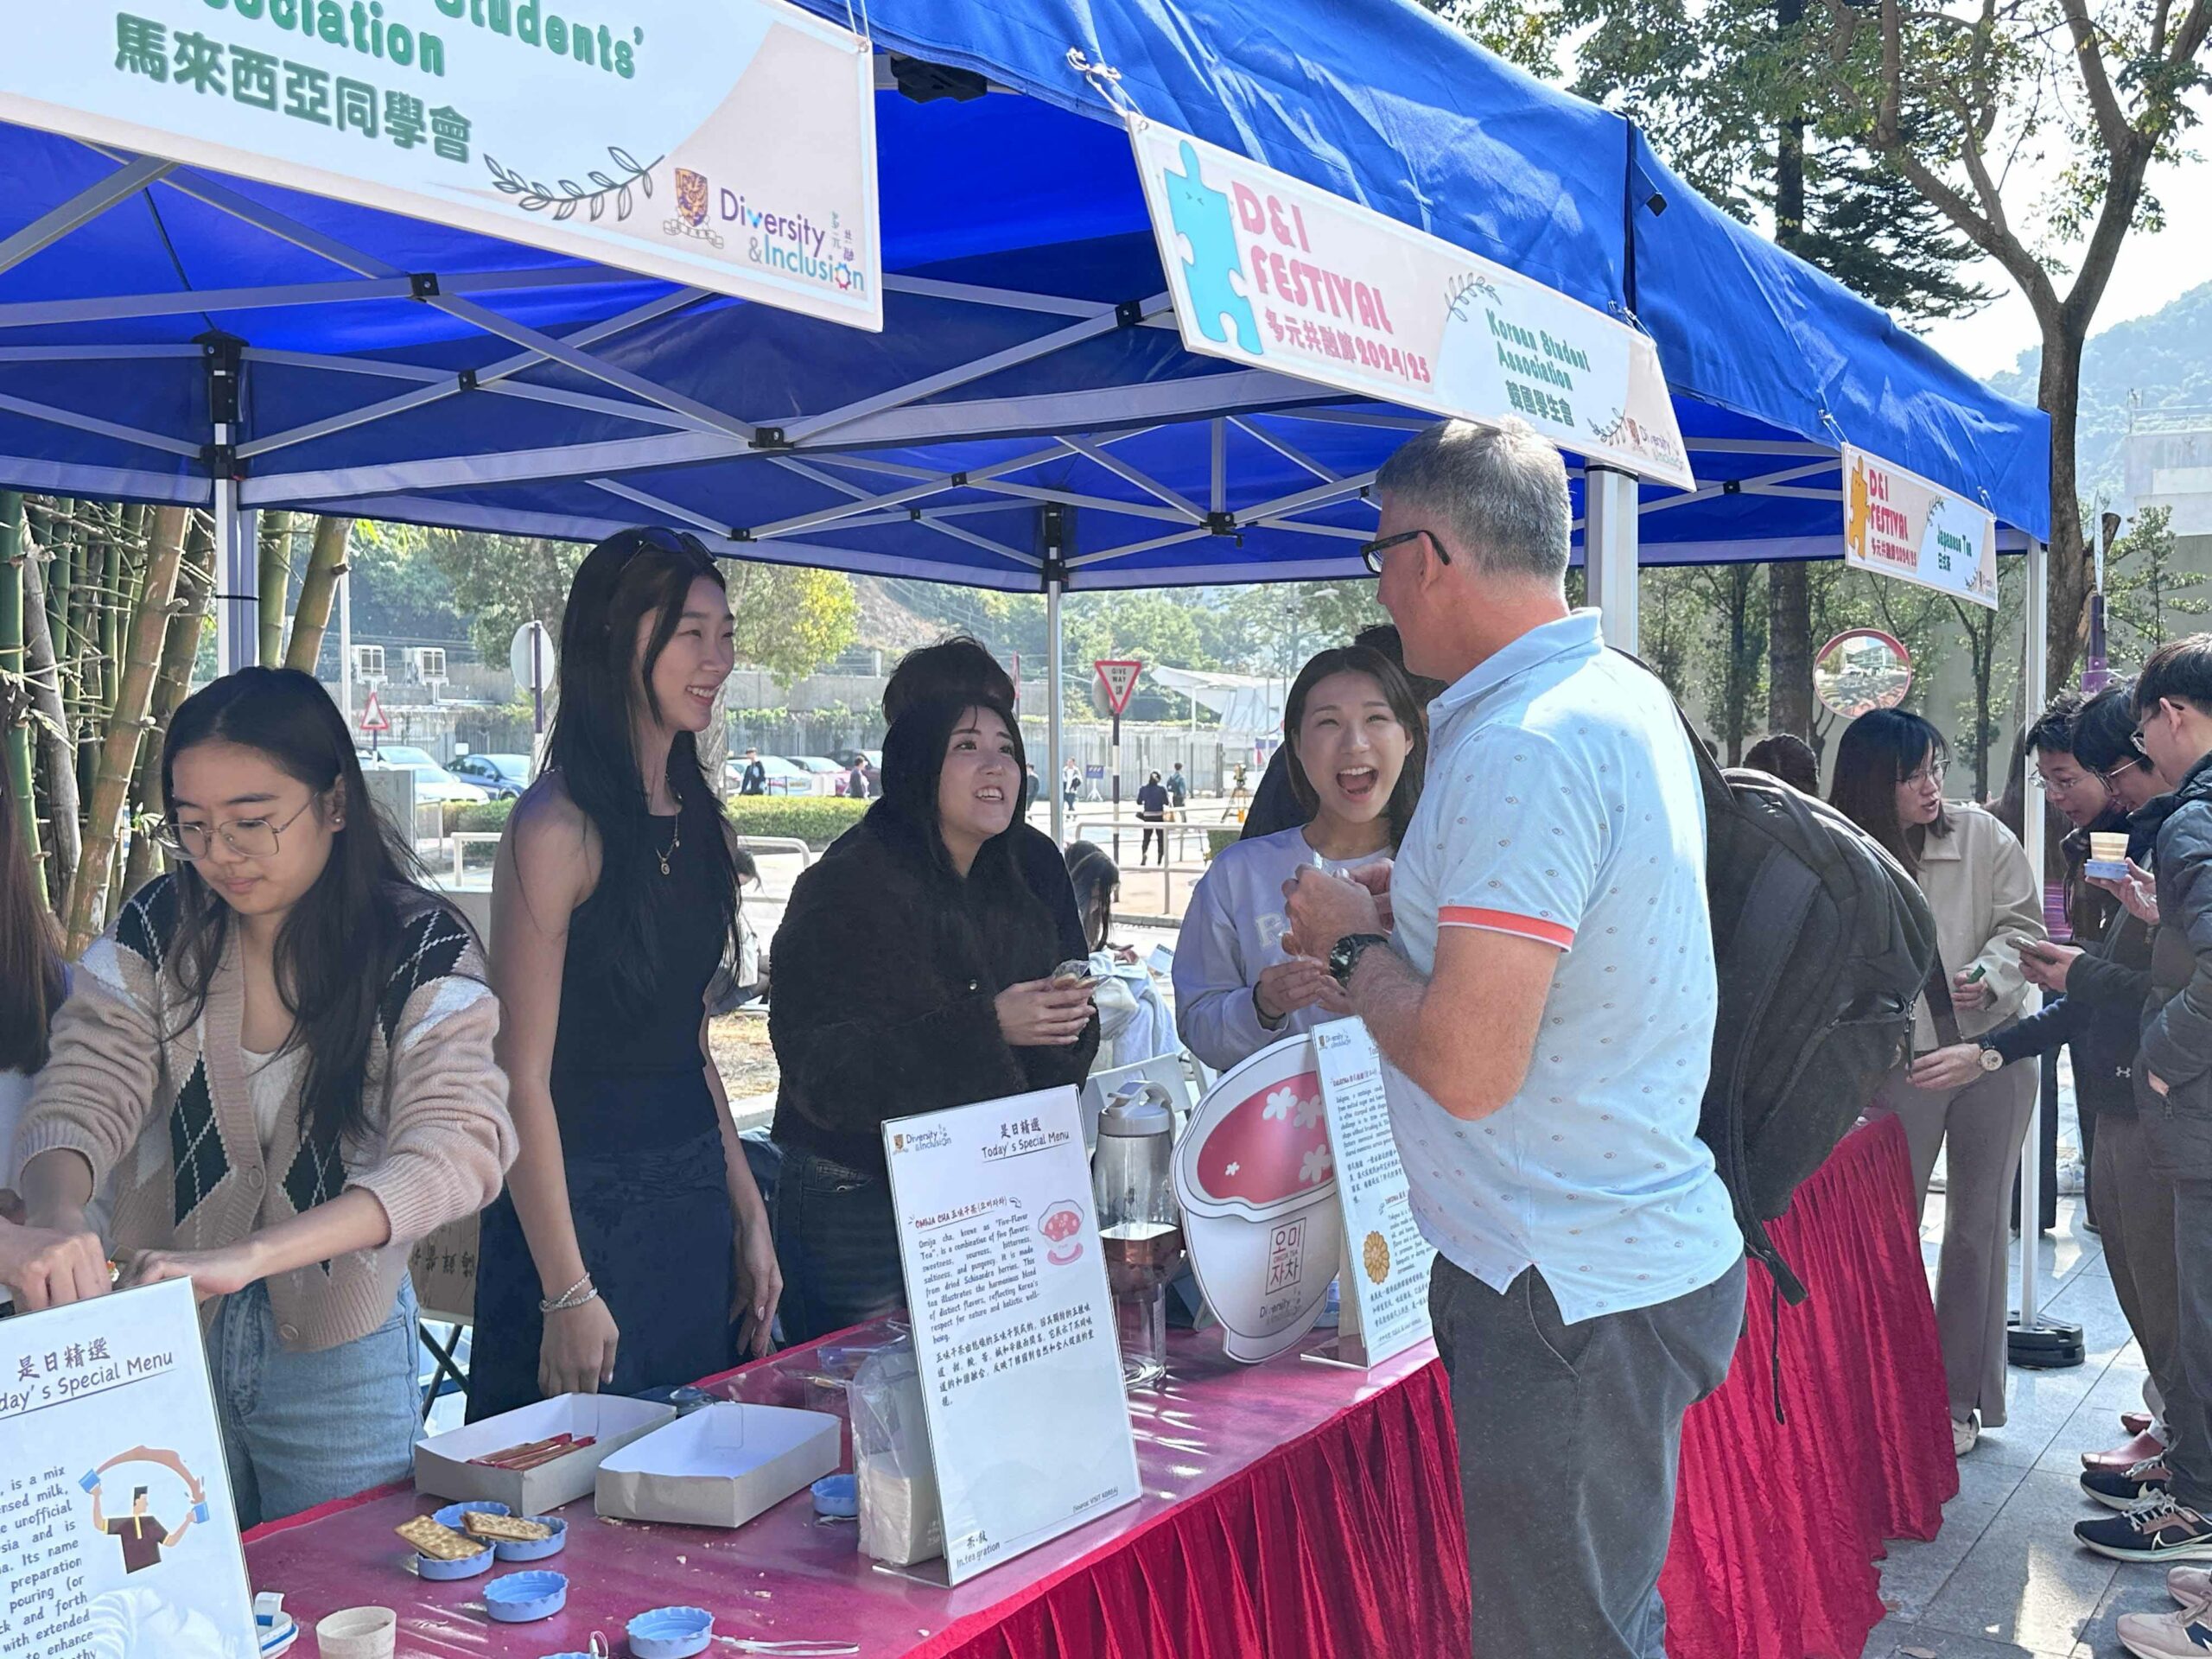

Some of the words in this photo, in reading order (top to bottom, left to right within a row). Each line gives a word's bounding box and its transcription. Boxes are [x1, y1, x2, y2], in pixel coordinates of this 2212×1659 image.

[115, 12, 472, 164] 馬來西亞同學會
[721, 187, 825, 258] Diversity
[1231, 180, 1312, 253] D&I
[1250, 245, 1394, 334] FESTIVAL
[1486, 308, 1537, 351] Korean
[1540, 330, 1591, 372] Student
[1497, 341, 1573, 391] Association
[1505, 379, 1574, 427] 韓國學生會
[1869, 468, 1889, 502] D&I
[1871, 503, 1908, 542] FESTIVAL
[1937, 523, 1961, 552] Japanese
[1962, 534, 1972, 558] Tea
[906, 1130, 938, 1144] Diversity
[1001, 1117, 1041, 1139] 是日精選
[1019, 1135, 1046, 1153] Special
[1048, 1130, 1070, 1142] Menu
[916, 1217, 935, 1229] OMIJA
[955, 1236, 987, 1251] combination
[988, 1231, 995, 1243] of
[996, 1230, 1007, 1241] five
[1273, 1224, 1300, 1255] 오미
[919, 1239, 936, 1249] Omija
[957, 1263, 967, 1274] and
[1020, 1245, 1033, 1255] made
[925, 1287, 940, 1298] from
[944, 1279, 960, 1290] dried
[1023, 1257, 1035, 1267] This
[941, 1289, 972, 1303] illustrates
[976, 1284, 985, 1293] the
[988, 1274, 1019, 1288] harmonious
[1022, 1267, 1036, 1279] blend
[1270, 1257, 1299, 1286] 자차
[929, 1310, 936, 1321] of
[939, 1304, 960, 1317] distinct
[988, 1287, 1015, 1301] reflecting
[1018, 1280, 1038, 1291] Korea's
[931, 1319, 952, 1332] respect
[956, 1314, 965, 1325] for
[969, 1308, 987, 1319] nature
[990, 1302, 1000, 1313] and
[1002, 1297, 1023, 1308] holistic
[17, 1337, 111, 1382] 是日精選
[58, 1363, 120, 1396] Special
[127, 1351, 173, 1376] Menu
[11, 1479, 22, 1491] is
[29, 1476, 36, 1485] a
[44, 1466, 66, 1481] mix
[37, 1484, 68, 1502] milk,
[15, 1499, 73, 1529] unofficial
[32, 1525, 53, 1543] and
[65, 1520, 76, 1532] is
[22, 1552, 40, 1566] Its
[48, 1539, 79, 1556] name
[10, 1557, 82, 1593] preparation
[10, 1587, 54, 1614] pouring
[67, 1575, 85, 1592] (or
[23, 1607, 44, 1625] and
[55, 1592, 87, 1616] forth
[3, 1632, 29, 1652] with
[35, 1608, 90, 1639] extended
[48, 1631, 93, 1656] enhance
